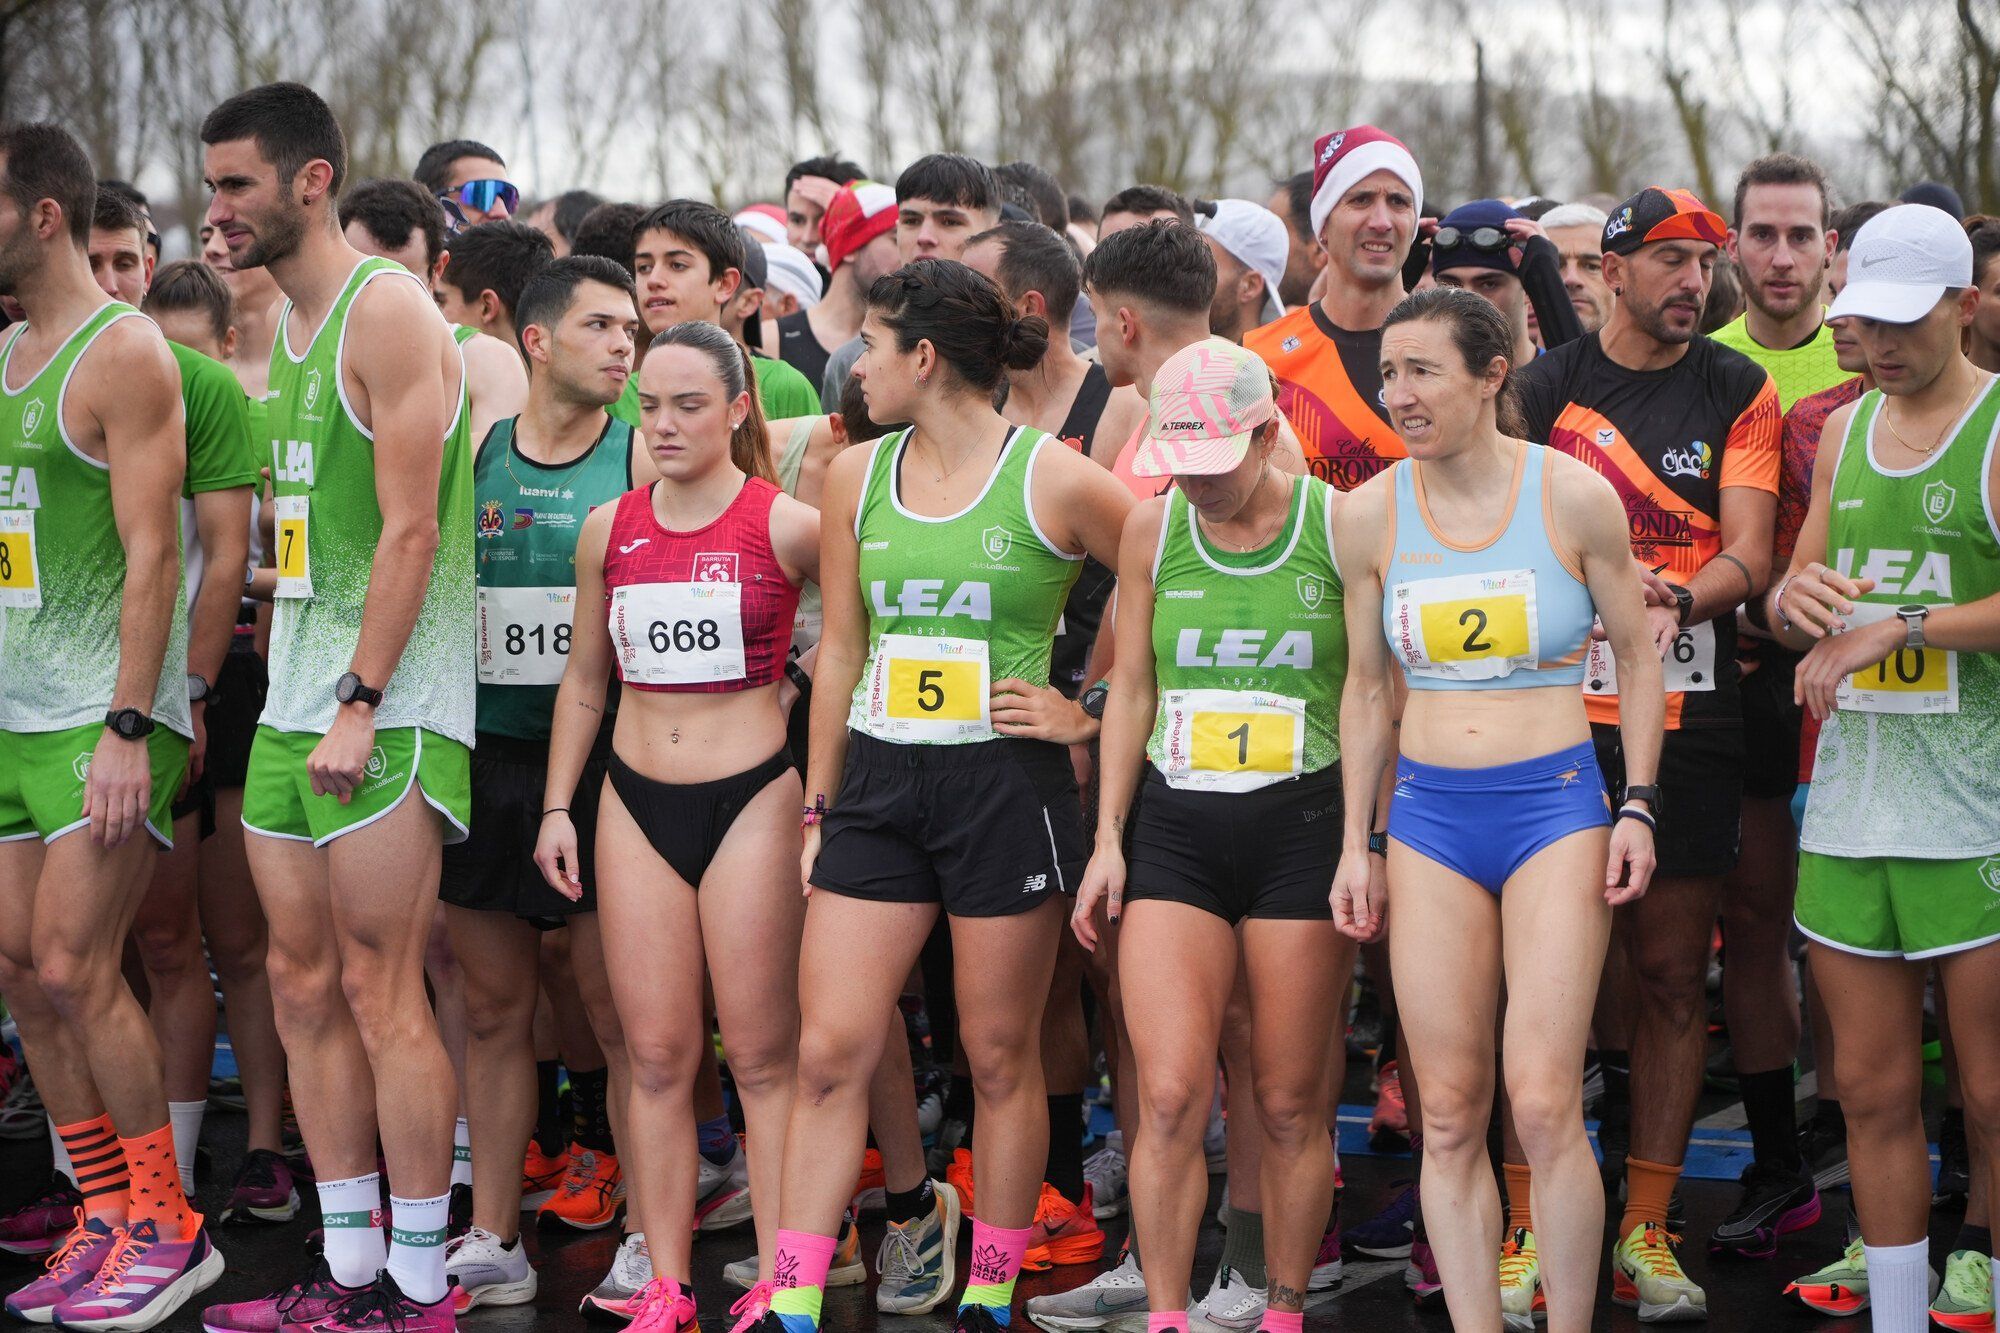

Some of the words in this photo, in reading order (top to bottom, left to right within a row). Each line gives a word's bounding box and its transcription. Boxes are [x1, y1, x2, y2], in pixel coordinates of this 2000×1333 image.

[1171, 421, 1206, 430] TERREX
[1337, 437, 1377, 457] Cafés
[0, 465, 41, 509] EA
[520, 485, 560, 498] luanvi
[1629, 512, 1692, 539] ONDA
[285, 530, 294, 569] 7
[0, 542, 11, 580] 8
[1837, 548, 1953, 598] LEA
[1481, 578, 1506, 590] Vital
[546, 592, 571, 603] Vital
[691, 587, 715, 598] Vital
[870, 579, 992, 621] LEA
[648, 619, 721, 654] 668
[1459, 609, 1491, 652] 2
[505, 623, 573, 656] 818
[630, 648, 636, 659] 23
[938, 643, 963, 654] Vital
[1176, 629, 1313, 669] LEA
[1412, 650, 1422, 660] 23
[1599, 661, 1607, 671] 23
[918, 671, 944, 712] 5
[877, 701, 883, 712] 23
[1252, 696, 1278, 707] Vital
[1228, 722, 1249, 764] 1
[1178, 755, 1186, 766] 23
[392, 1232, 437, 1243] ATLÓN
